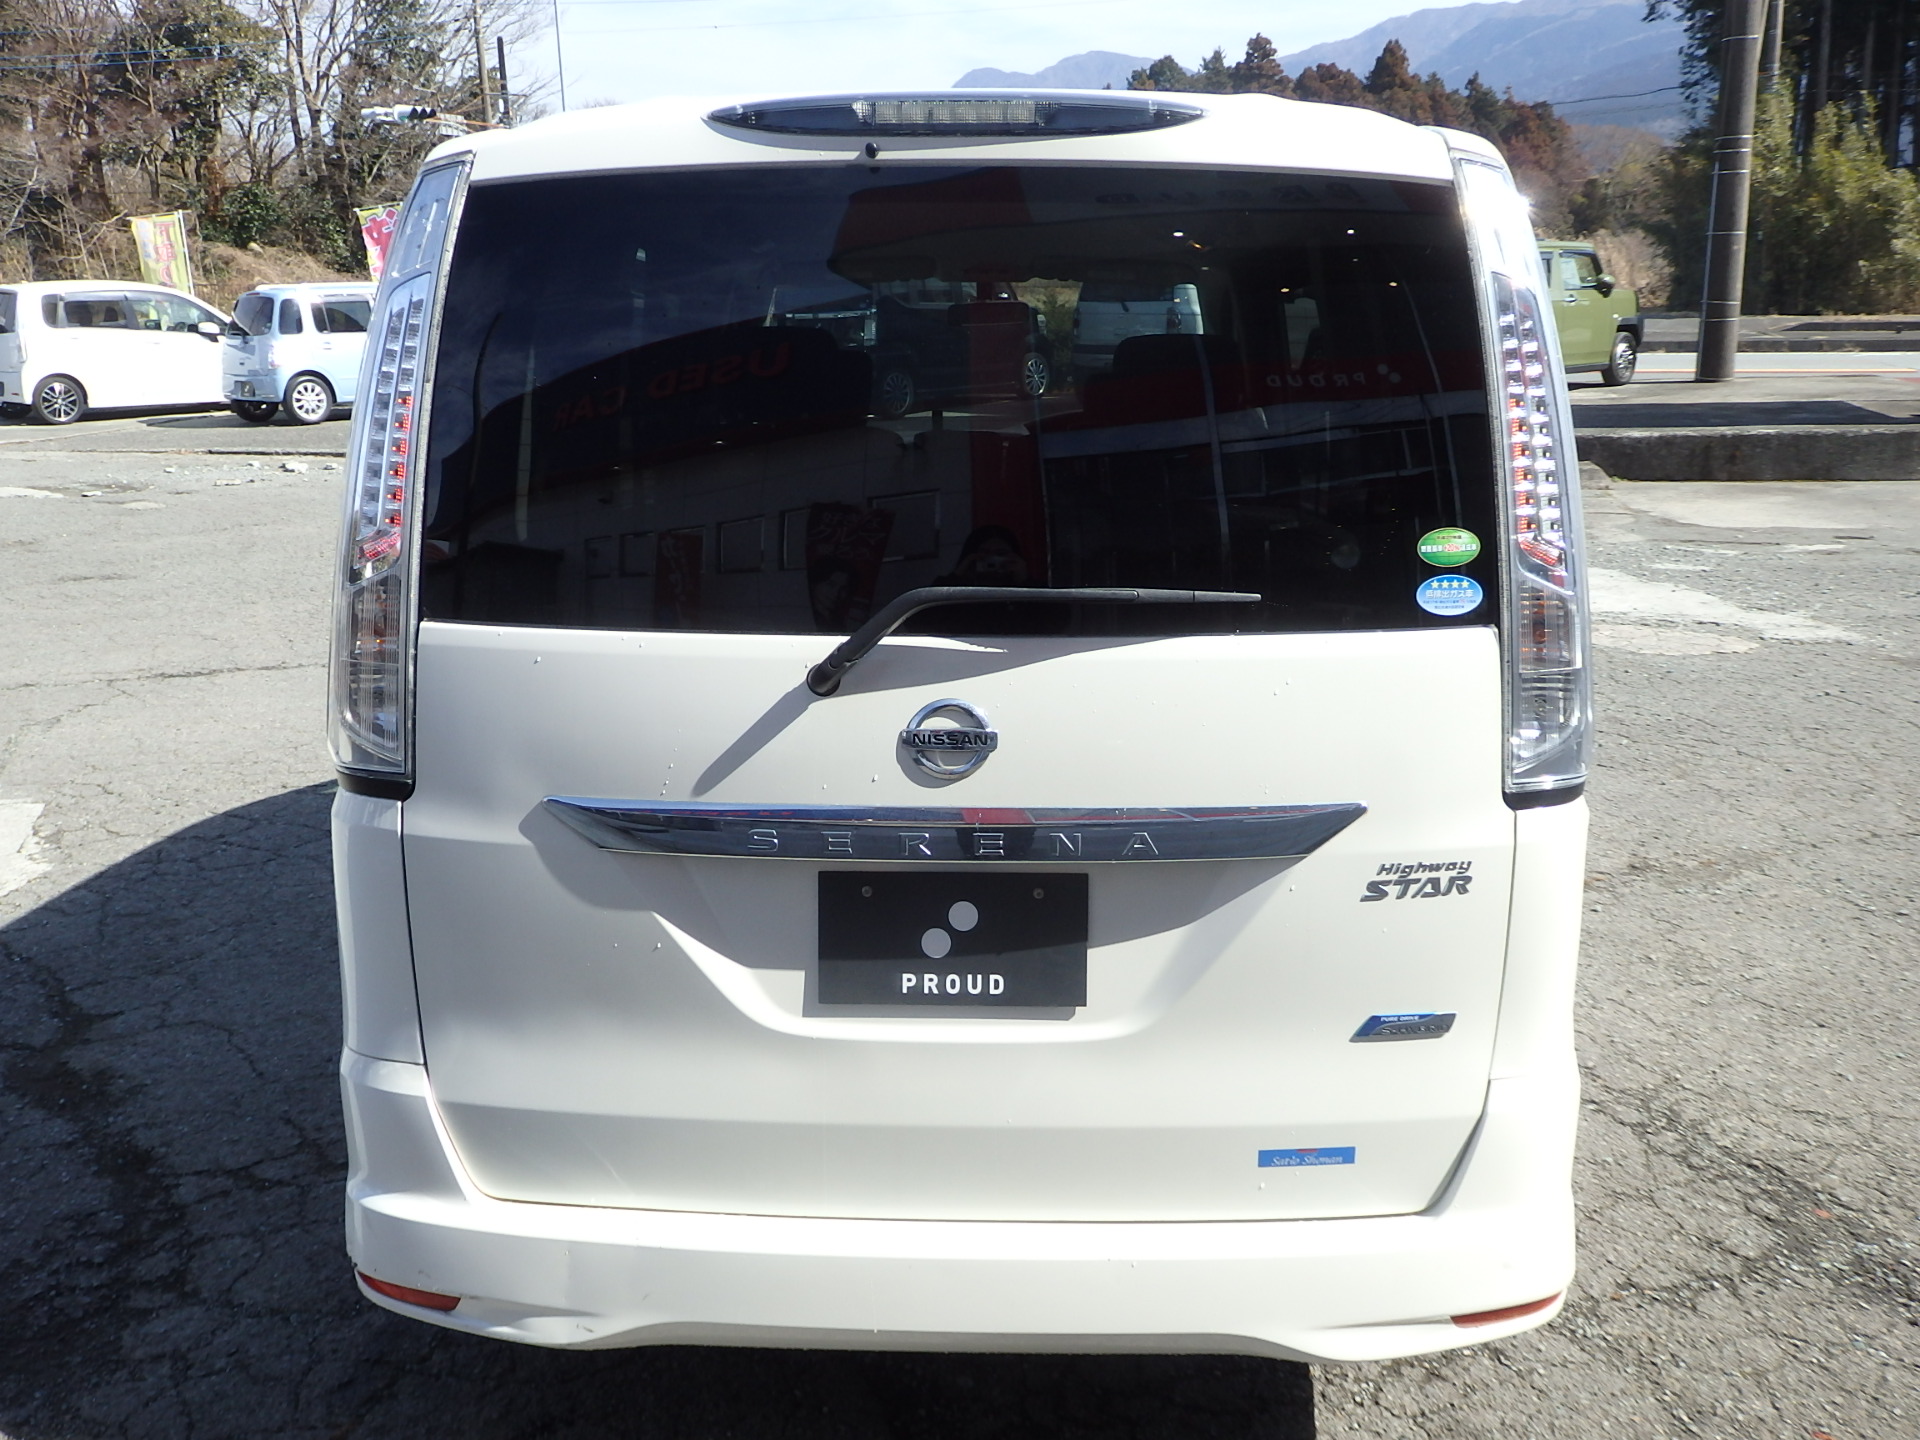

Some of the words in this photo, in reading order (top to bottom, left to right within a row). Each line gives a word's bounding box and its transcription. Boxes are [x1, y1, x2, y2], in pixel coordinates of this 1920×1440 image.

[911, 732, 989, 747] NISSAN
[747, 828, 1159, 856] SERENA
[1376, 860, 1472, 879] Highway
[1360, 875, 1473, 902] STAR
[901, 973, 1005, 995] PROUD
